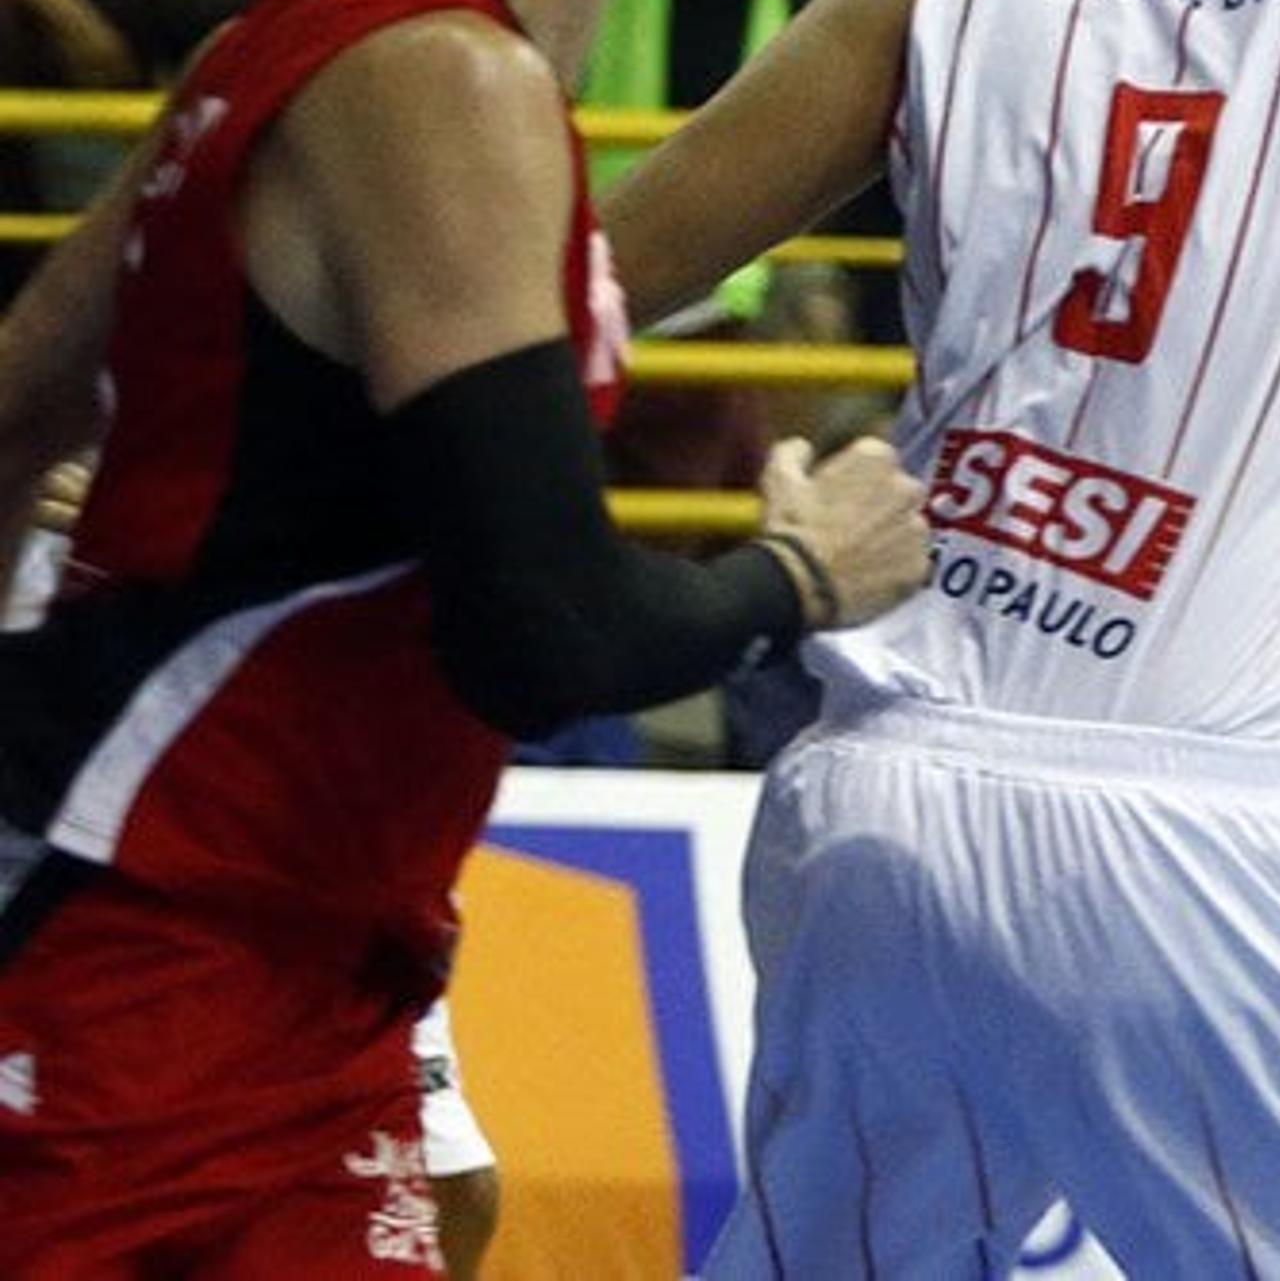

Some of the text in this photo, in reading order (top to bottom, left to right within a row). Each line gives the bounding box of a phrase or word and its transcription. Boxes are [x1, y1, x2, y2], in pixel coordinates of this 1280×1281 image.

[1051, 81, 1227, 365] 9
[930, 438, 1170, 576] SESI
[978, 568, 1136, 660] PAULO
